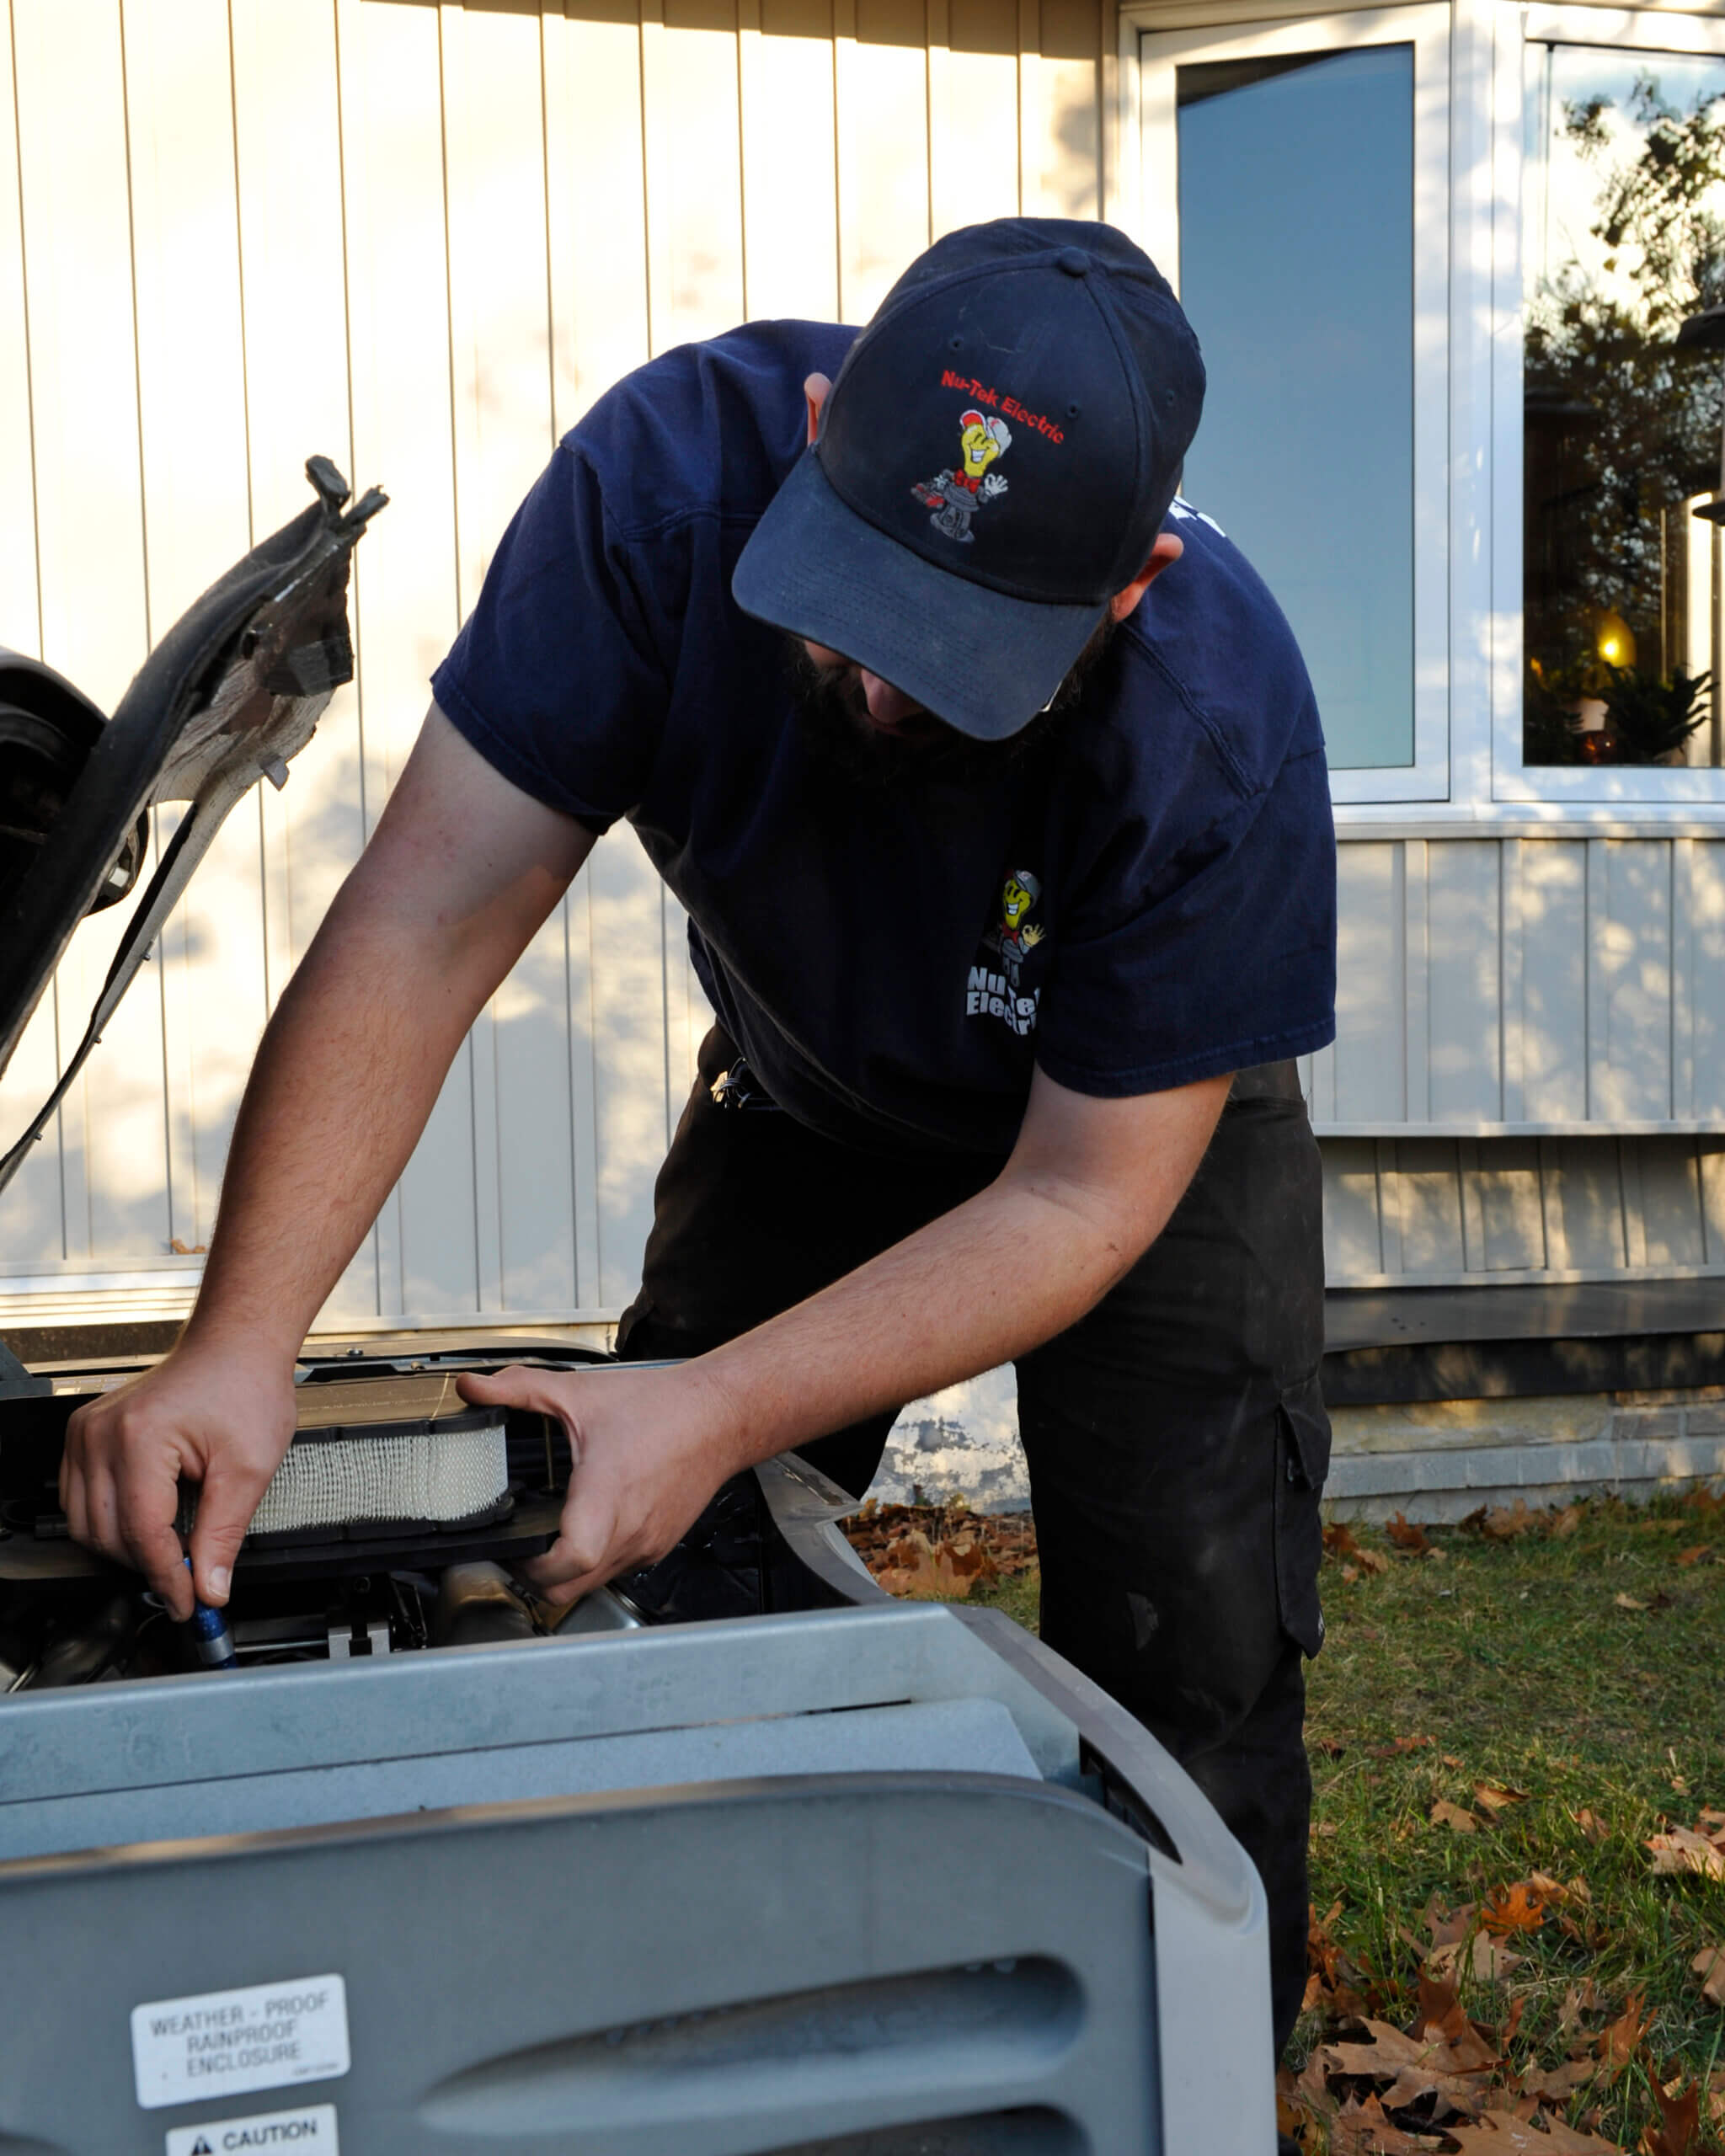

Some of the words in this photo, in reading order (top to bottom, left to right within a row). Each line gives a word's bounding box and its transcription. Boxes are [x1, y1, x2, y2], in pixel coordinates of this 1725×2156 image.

[941, 370, 998, 407] Nu-Tek
[1000, 397, 1064, 445] Electric
[149, 2005, 243, 2037] WEATHER
[264, 1990, 329, 2020] PROOF
[187, 2019, 297, 2055] RAINPROOF
[187, 2041, 301, 2078] ENCLOSURE
[222, 2119, 318, 2150] CAUTION
